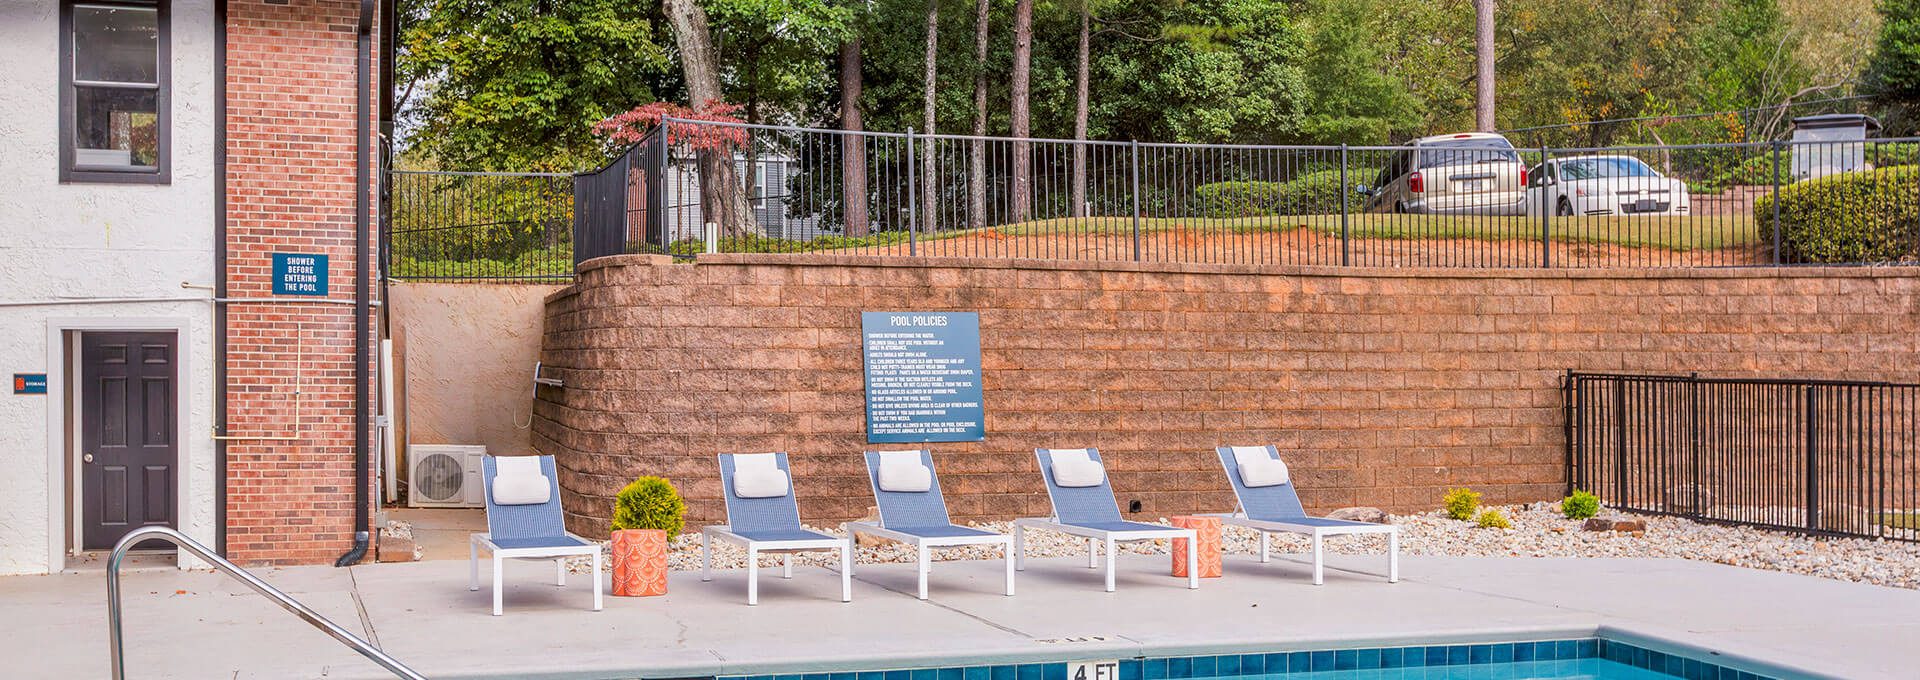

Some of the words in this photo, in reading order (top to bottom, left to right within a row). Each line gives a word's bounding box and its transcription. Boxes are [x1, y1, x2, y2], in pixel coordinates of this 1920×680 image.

[287, 257, 315, 266] SHOWER
[288, 266, 314, 274] BEFORE
[284, 274, 317, 283] ENTERING
[284, 283, 298, 291] THE
[300, 283, 317, 292] POOL
[890, 316, 911, 326] POOL
[913, 316, 948, 326] POLICIES
[1074, 664, 1087, 680] 4
[1096, 663, 1116, 680] FT
